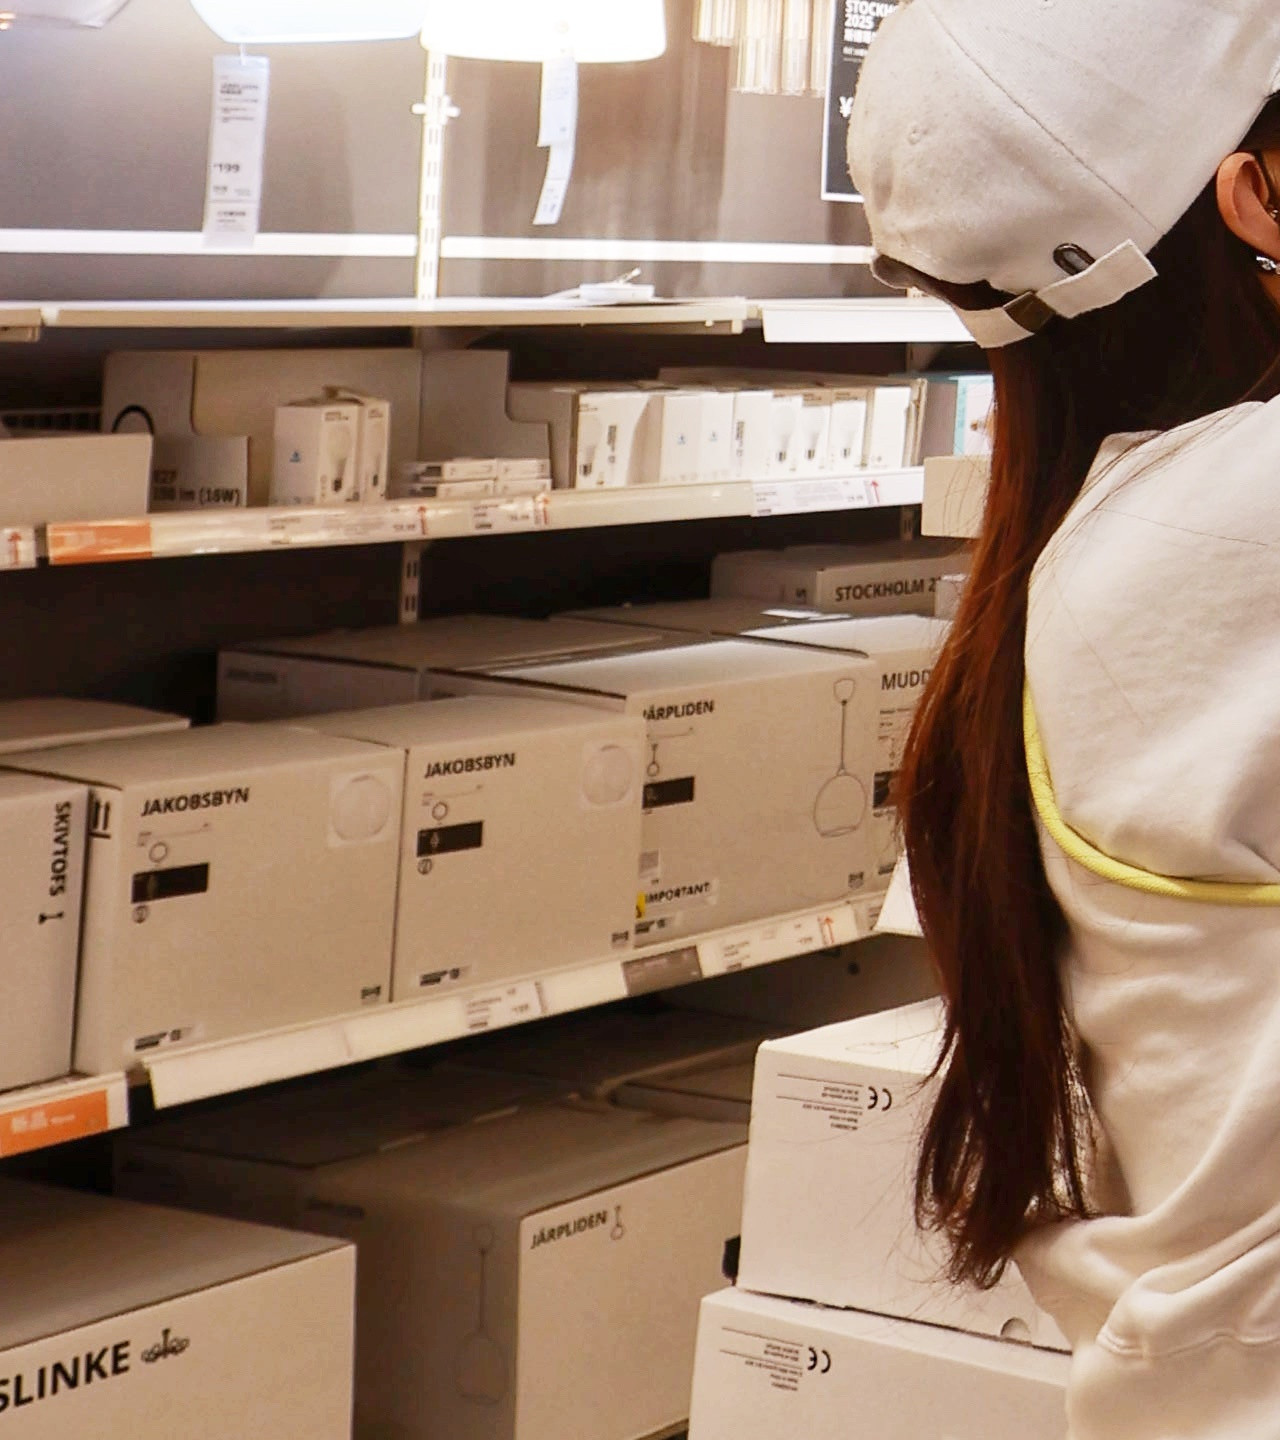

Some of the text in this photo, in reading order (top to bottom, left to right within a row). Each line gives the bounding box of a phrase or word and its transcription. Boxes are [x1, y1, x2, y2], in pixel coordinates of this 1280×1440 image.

[834, 578, 924, 602] STOCKHOLM
[423, 752, 517, 780] JAKOBSBYN
[140, 787, 250, 818] JAKOBSBYN
[49, 800, 72, 898] SKIVTOFS
